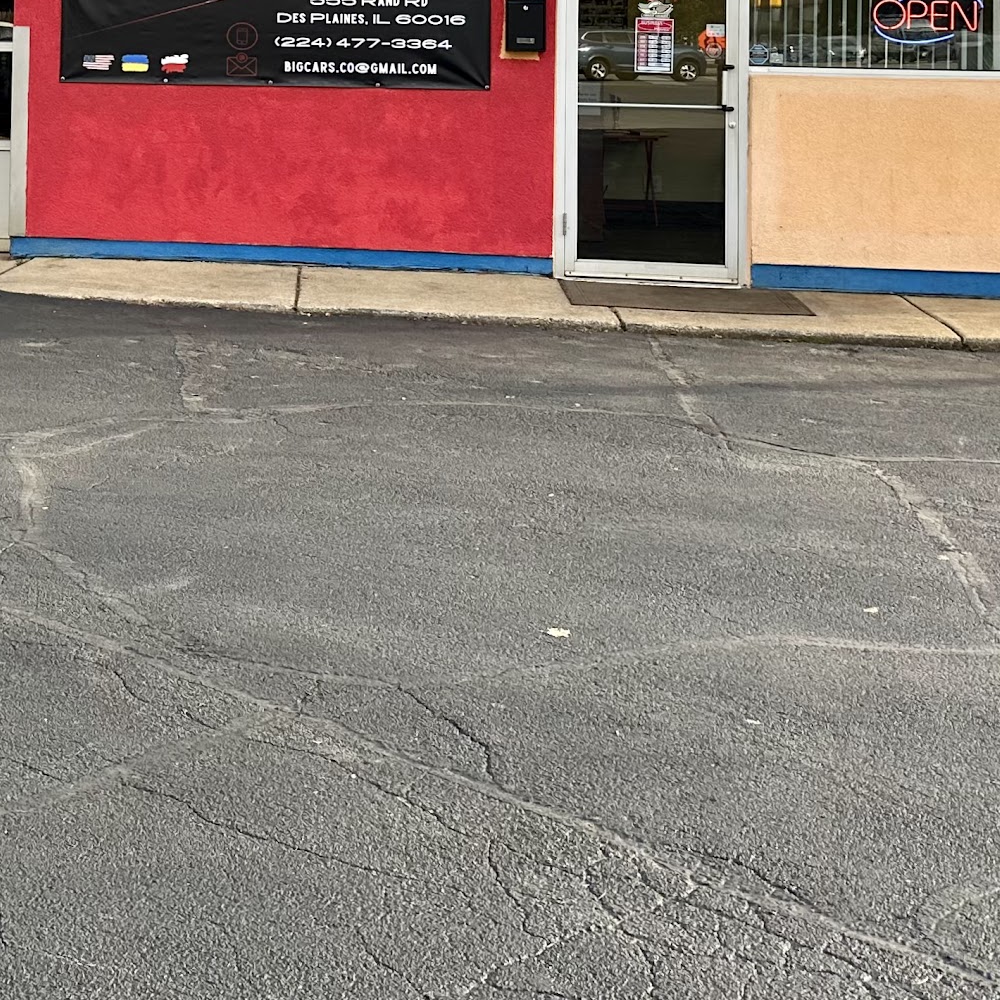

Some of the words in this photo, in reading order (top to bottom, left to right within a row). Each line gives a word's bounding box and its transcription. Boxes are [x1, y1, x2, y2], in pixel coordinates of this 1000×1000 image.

[372, 14, 391, 25] IL
[395, 14, 467, 26] 60016
[873, 0, 978, 32] OPEN
[274, 36, 332, 48] (224)
[335, 38, 452, 50] 477-3364
[284, 61, 438, 75] BIGCARS.CO@GMAIL.COM
